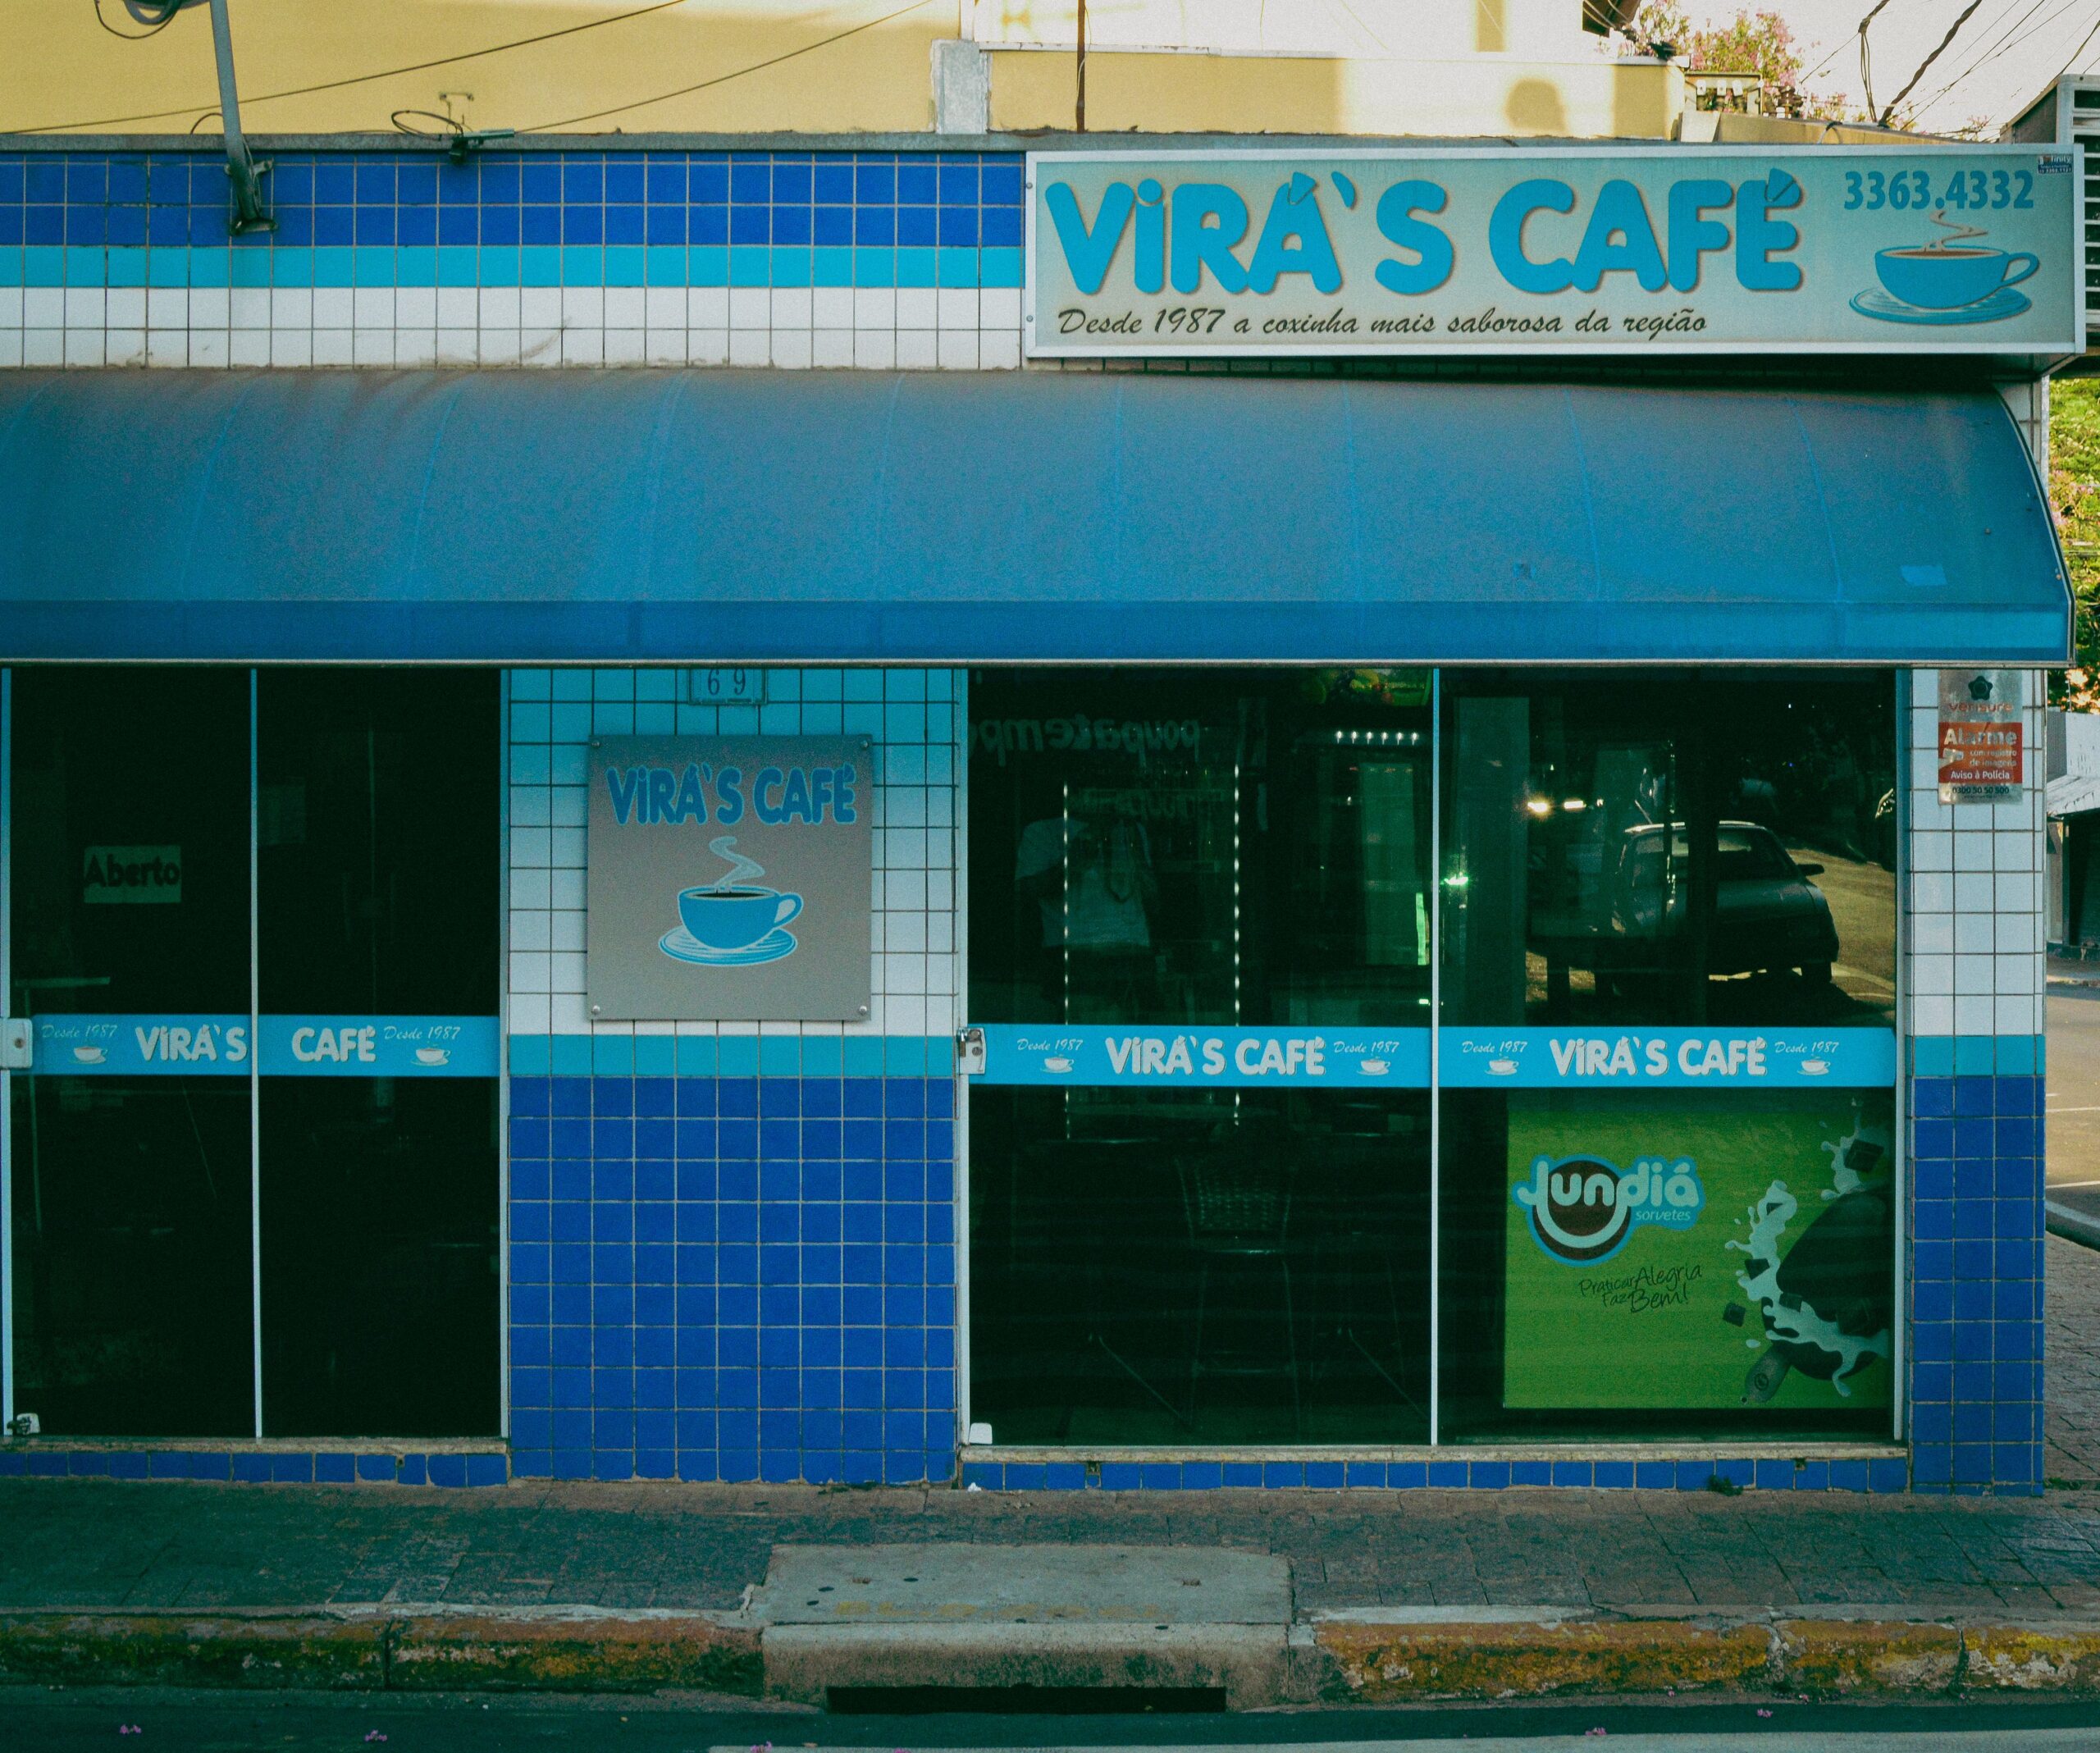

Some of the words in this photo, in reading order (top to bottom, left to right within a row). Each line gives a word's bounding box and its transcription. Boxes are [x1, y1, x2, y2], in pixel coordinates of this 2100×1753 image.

[1844, 170, 2034, 211] 3363.4332
[1489, 167, 1802, 293] CAFÉ
[1058, 308, 1143, 335] Desde
[1153, 308, 1226, 335] 1987
[1234, 317, 1252, 334] a
[1262, 308, 1358, 335] coxinha
[1370, 314, 1436, 334] mais
[1447, 307, 1564, 334] saborosa
[1574, 308, 1612, 334] da
[1623, 308, 1707, 341] região
[1943, 728, 2017, 746] Alarme
[1951, 770, 1972, 779] Aviso
[1982, 769, 2011, 779] Polícia
[752, 762, 857, 825] CAFÉ
[1952, 786, 1971, 794] 0300
[84, 855, 181, 888] Aberto
[41, 1025, 80, 1039] Desde
[84, 1025, 118, 1039] 1987
[291, 1025, 377, 1062] CAFÉ
[383, 1025, 423, 1040] Desde
[427, 1025, 461, 1040] 1987
[1017, 1038, 1051, 1051] Desde
[1054, 1039, 1084, 1051] 1987
[1333, 1040, 1367, 1053] Desde
[1371, 1040, 1399, 1053] 1987
[1461, 1040, 1495, 1053] Desde
[1499, 1040, 1528, 1053] 1987
[1774, 1040, 1807, 1053] Desde
[1810, 1040, 1839, 1053] 1987
[1235, 1035, 1326, 1075] CAFÉ
[1678, 1036, 1767, 1076] CAFÉ
[1518, 1160, 1700, 1249] Jundiá
[1635, 1209, 1691, 1221] sorvetes
[1579, 1276, 1637, 1296] Praticar
[1635, 1264, 1703, 1292] Alegria
[1602, 1293, 1628, 1308] Faz
[1629, 1283, 1689, 1313] Bem!
